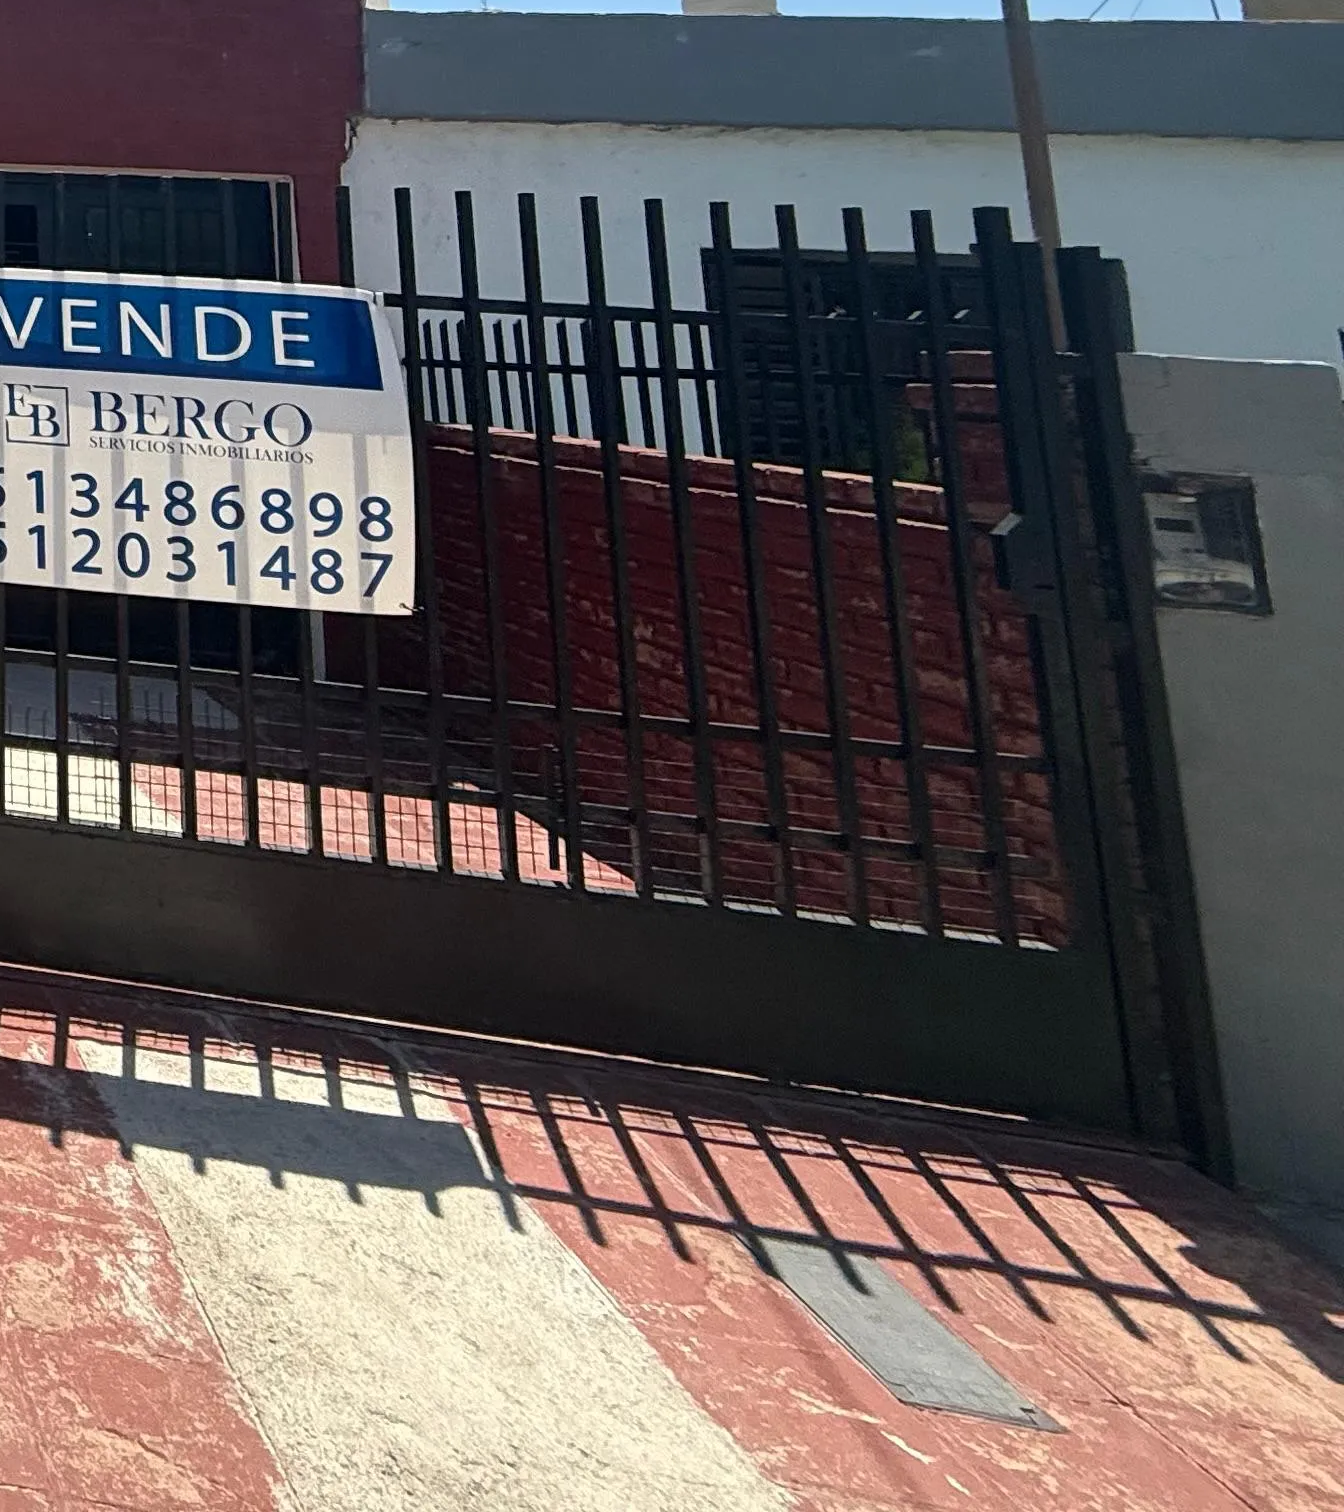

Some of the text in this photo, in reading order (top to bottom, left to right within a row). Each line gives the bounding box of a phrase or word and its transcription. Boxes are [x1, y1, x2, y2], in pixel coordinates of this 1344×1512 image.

[88, 389, 314, 447] BERGO
[88, 436, 314, 465] SERVICIOS INMOBILIARIOS
